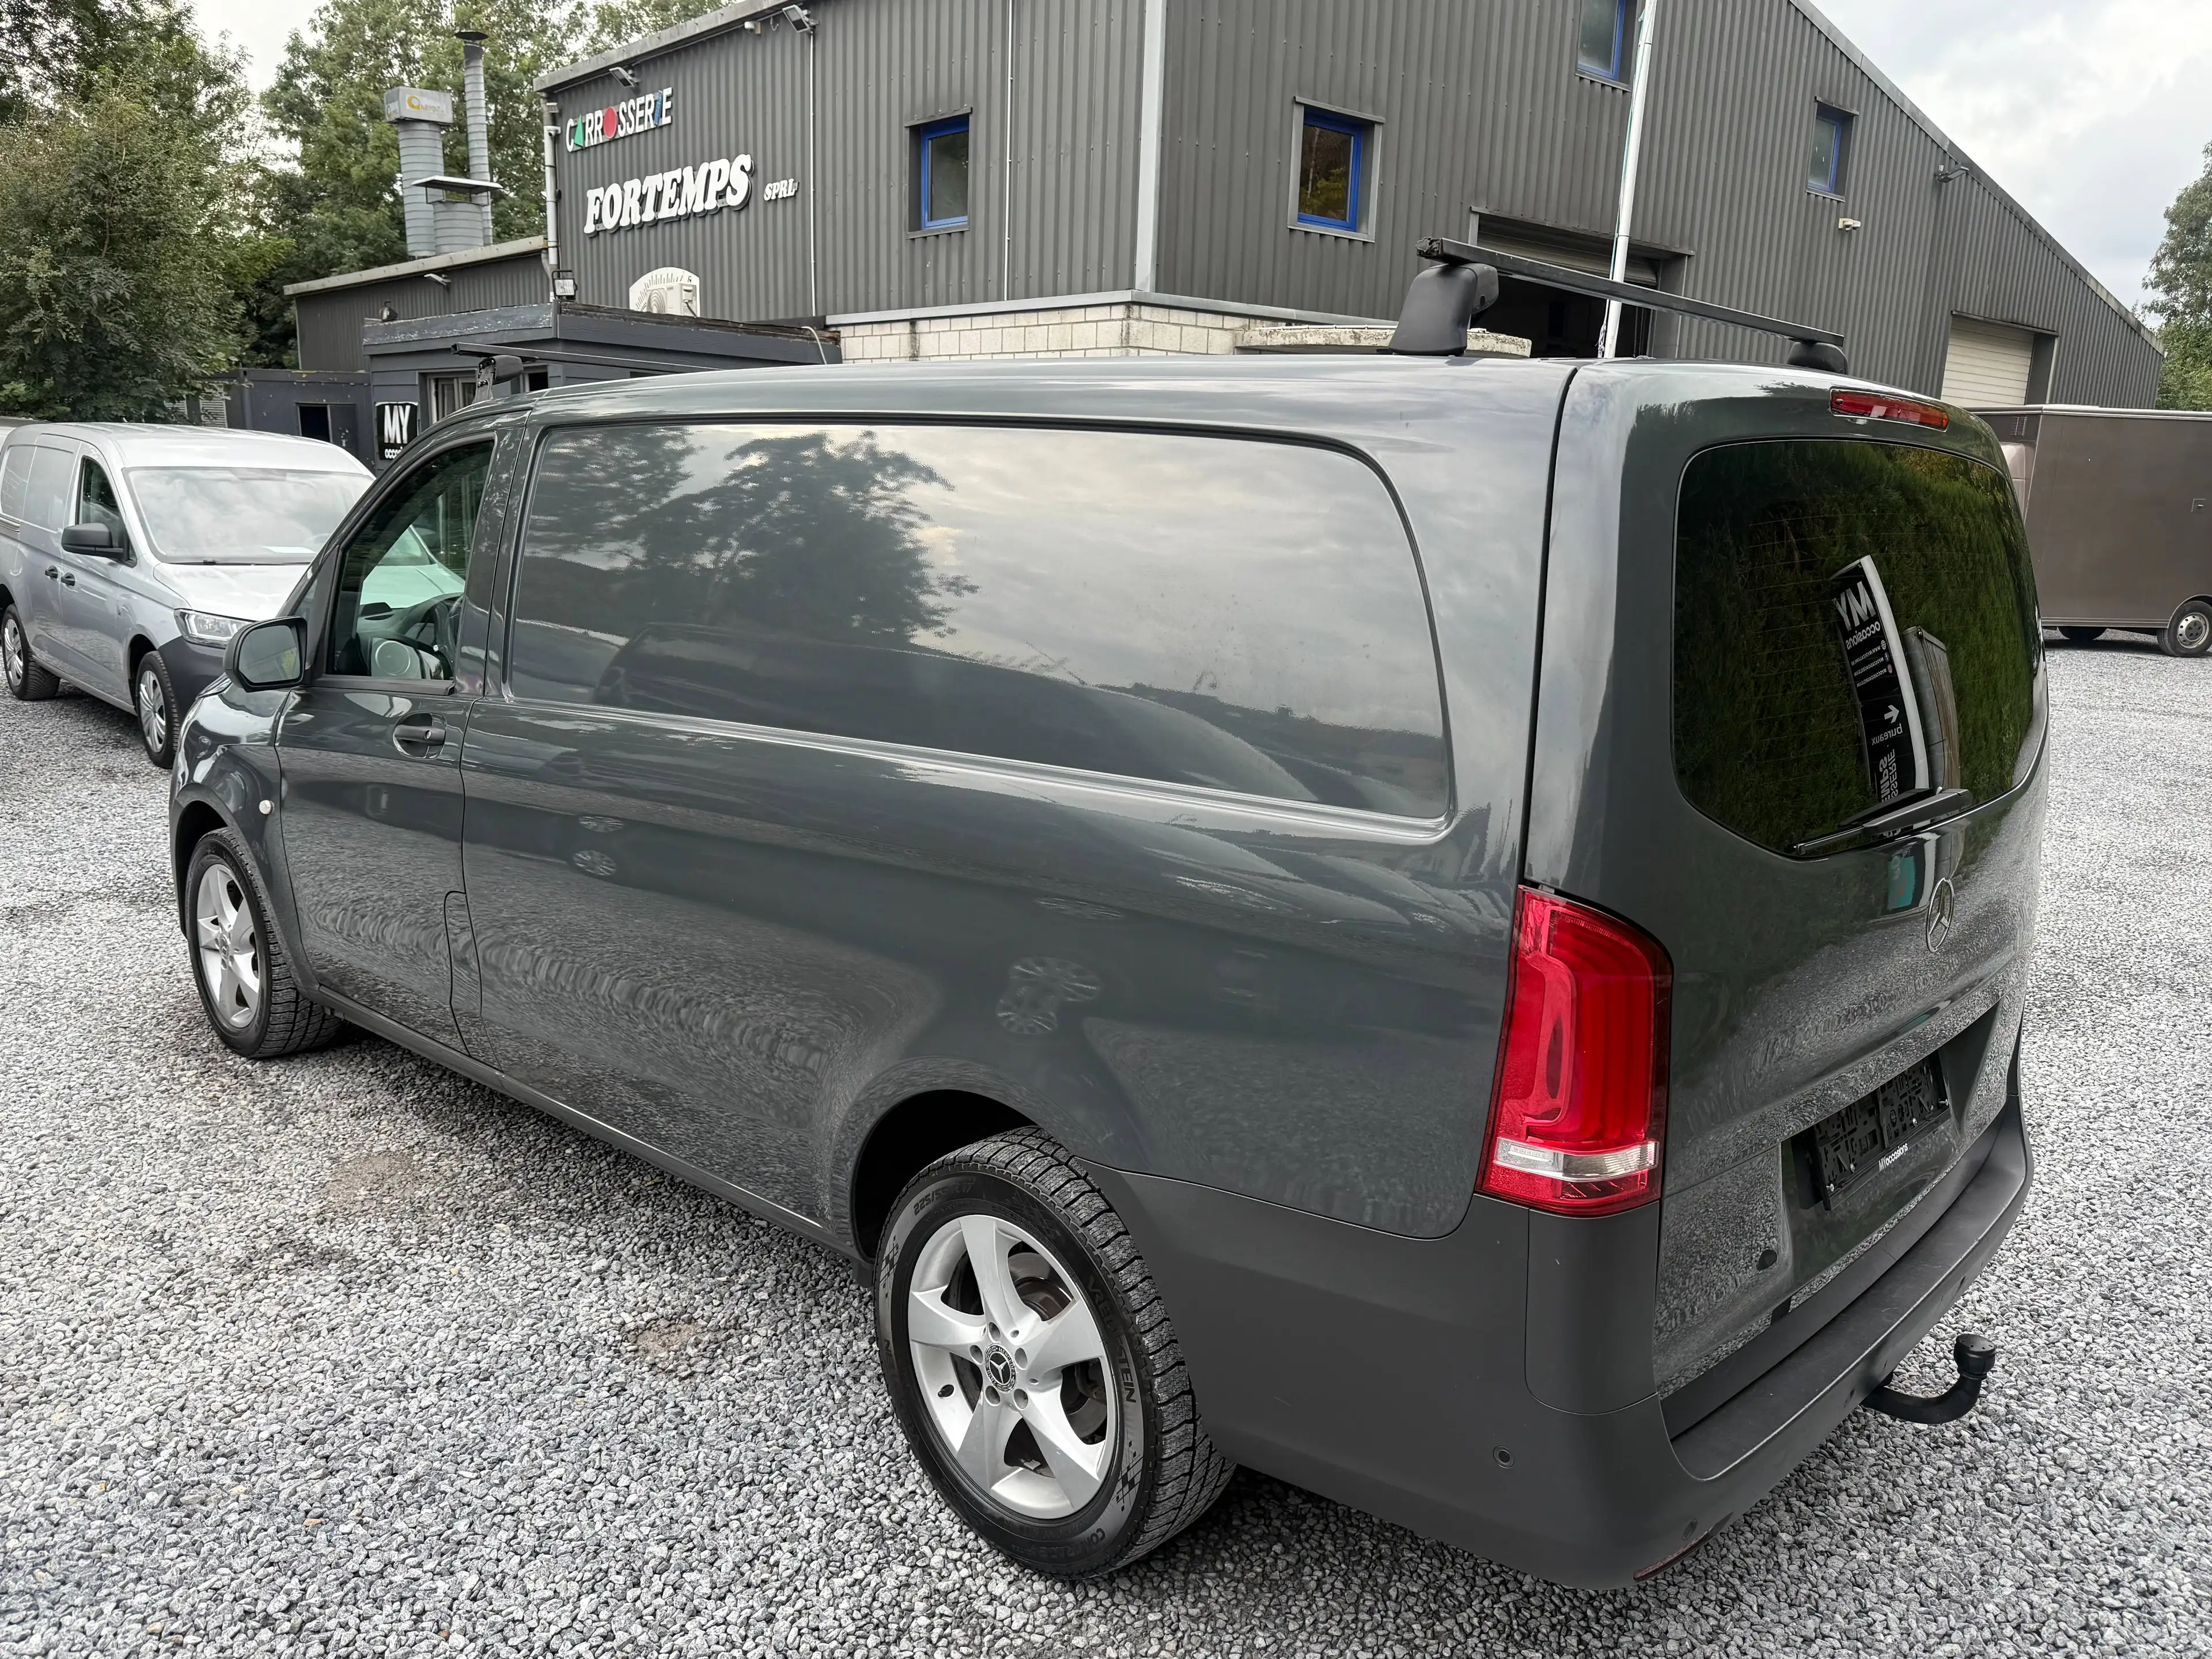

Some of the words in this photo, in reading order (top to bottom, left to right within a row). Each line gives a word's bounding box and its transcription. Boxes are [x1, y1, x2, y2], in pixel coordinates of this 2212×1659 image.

[566, 87, 673, 152] CARROSSERIE
[584, 154, 753, 235] FORTEMPS
[763, 179, 798, 201] SPRL
[384, 405, 411, 444] MY
[1878, 1143, 1908, 1172] MYoccasions
